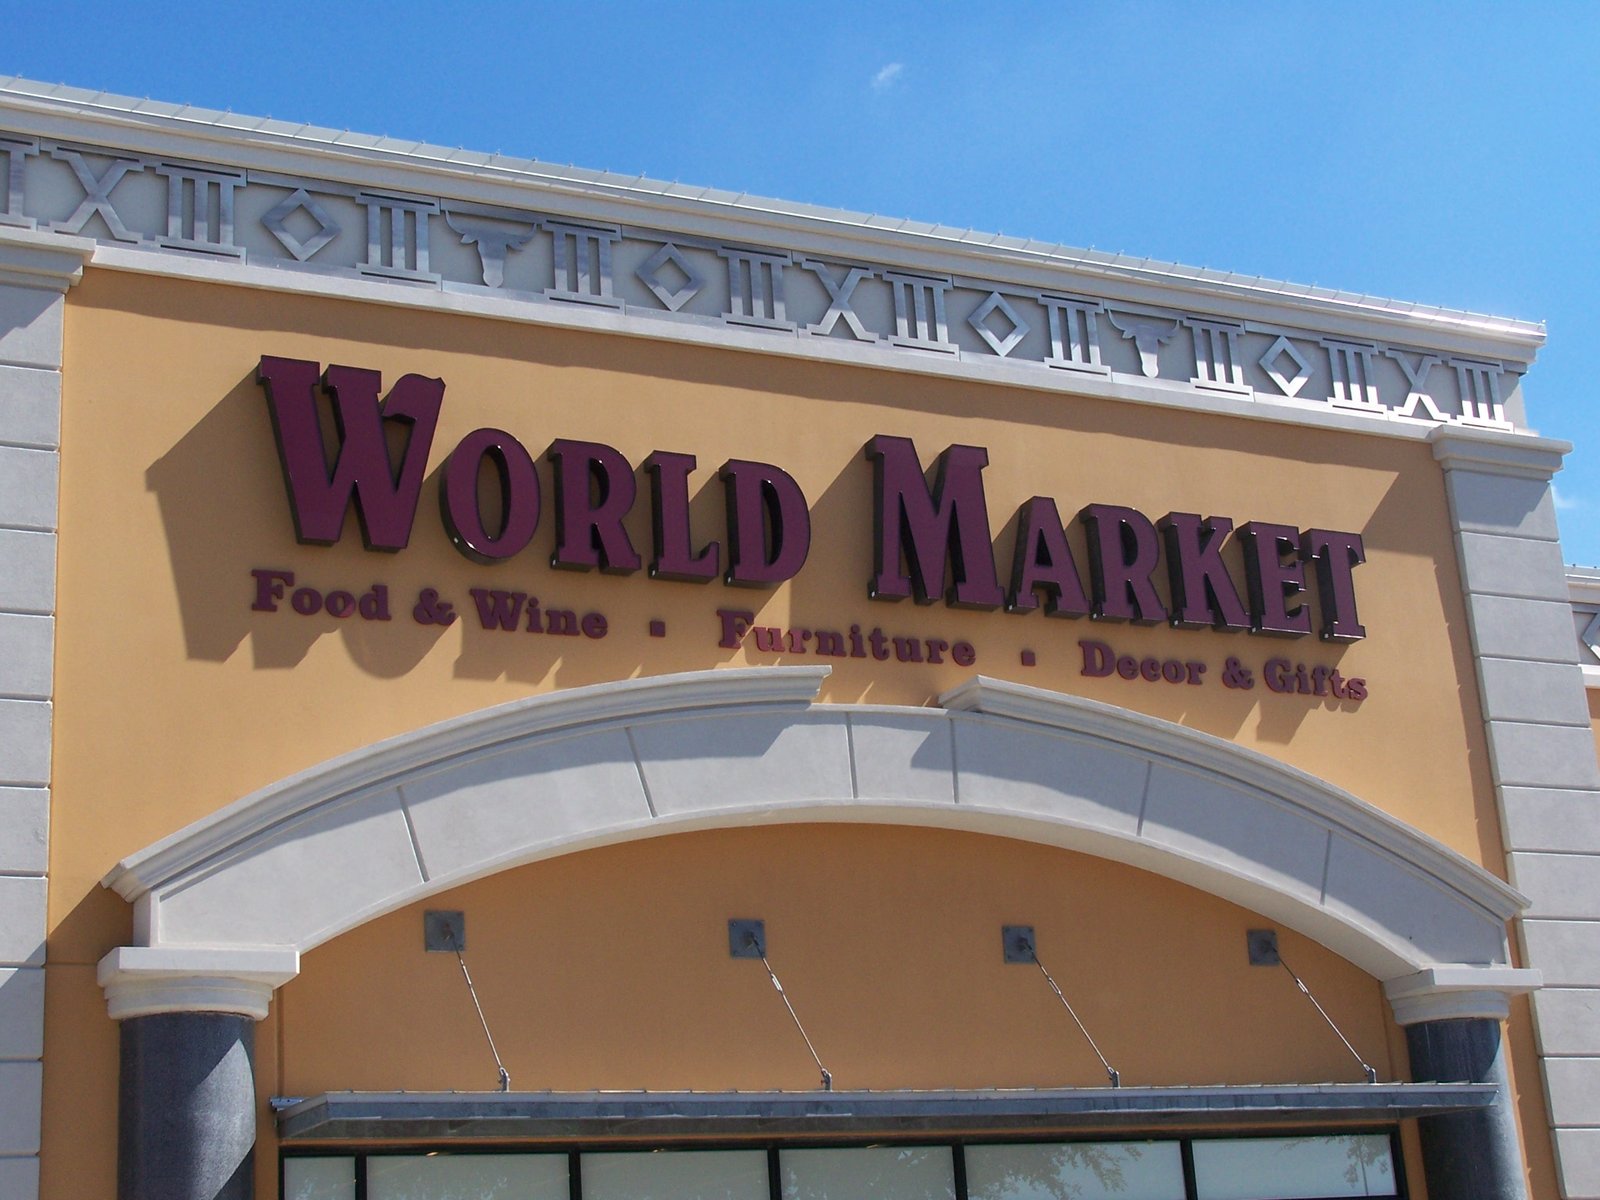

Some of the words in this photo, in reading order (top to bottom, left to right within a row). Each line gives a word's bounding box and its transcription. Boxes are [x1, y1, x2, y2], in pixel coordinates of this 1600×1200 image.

[256, 354, 811, 590] WORLD
[865, 434, 1366, 644] MARKET
[251, 569, 393, 622] Food
[412, 587, 457, 626] &
[469, 588, 609, 639] Wine
[716, 608, 976, 667] Furniture
[1078, 640, 1207, 686] Decor
[1221, 657, 1255, 691] &
[1263, 657, 1368, 702] Gifts
